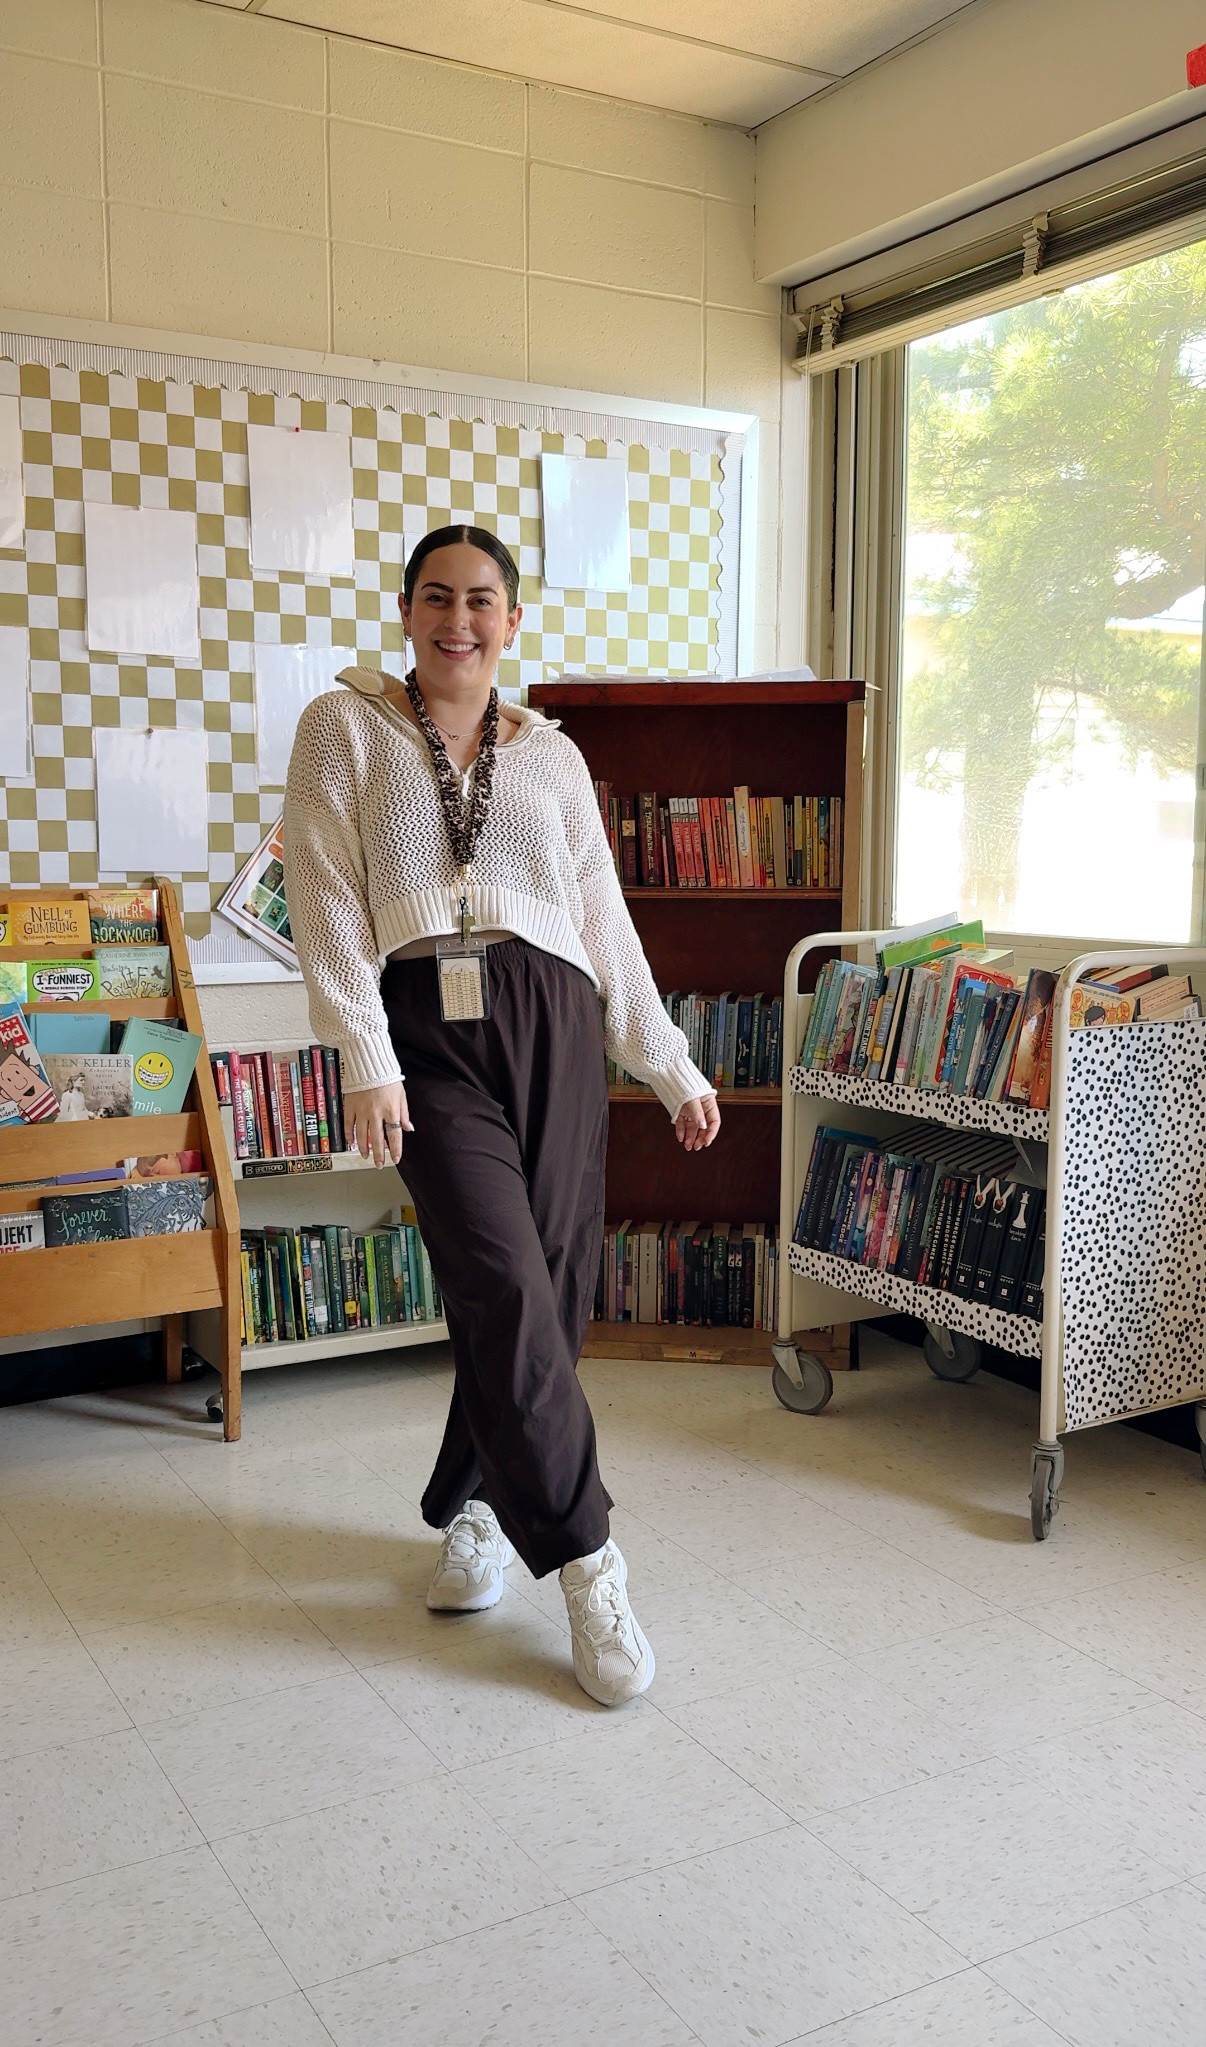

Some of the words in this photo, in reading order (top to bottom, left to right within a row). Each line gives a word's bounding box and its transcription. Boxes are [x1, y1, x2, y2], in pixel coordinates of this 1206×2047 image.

[30, 907, 63, 923] NELL
[64, 909, 73, 918] OF
[104, 904, 144, 919] WHERE
[23, 921, 78, 935] GUMBLING
[120, 920, 133, 928] THE
[37, 976, 44, 985] I
[47, 973, 91, 985] FUNNIEST
[951, 1013, 960, 1032] LOOK
[0, 1024, 23, 1042] kid
[947, 1032, 956, 1050] BOTH
[83, 1058, 132, 1068] KELLER
[943, 1051, 952, 1069] WAYS
[133, 1098, 162, 1114] mile
[235, 1090, 244, 1114] LOSERS
[243, 1090, 252, 1112] STORY
[279, 1090, 296, 1132] INKHEART
[245, 1114, 255, 1141] THIEVES
[305, 1113, 319, 1136] ZERO
[847, 1191, 855, 1207] ANA
[838, 1223, 847, 1244] EDGE
[934, 1212, 944, 1239] HUNGER
[944, 1216, 953, 1243] HUNGER
[951, 1217, 961, 1244] HUNGER
[929, 1239, 938, 1260] GAMES
[941, 1244, 949, 1264] GAMES
[946, 1244, 955, 1266] GAMES
[306, 1300, 315, 1320] DANCE
